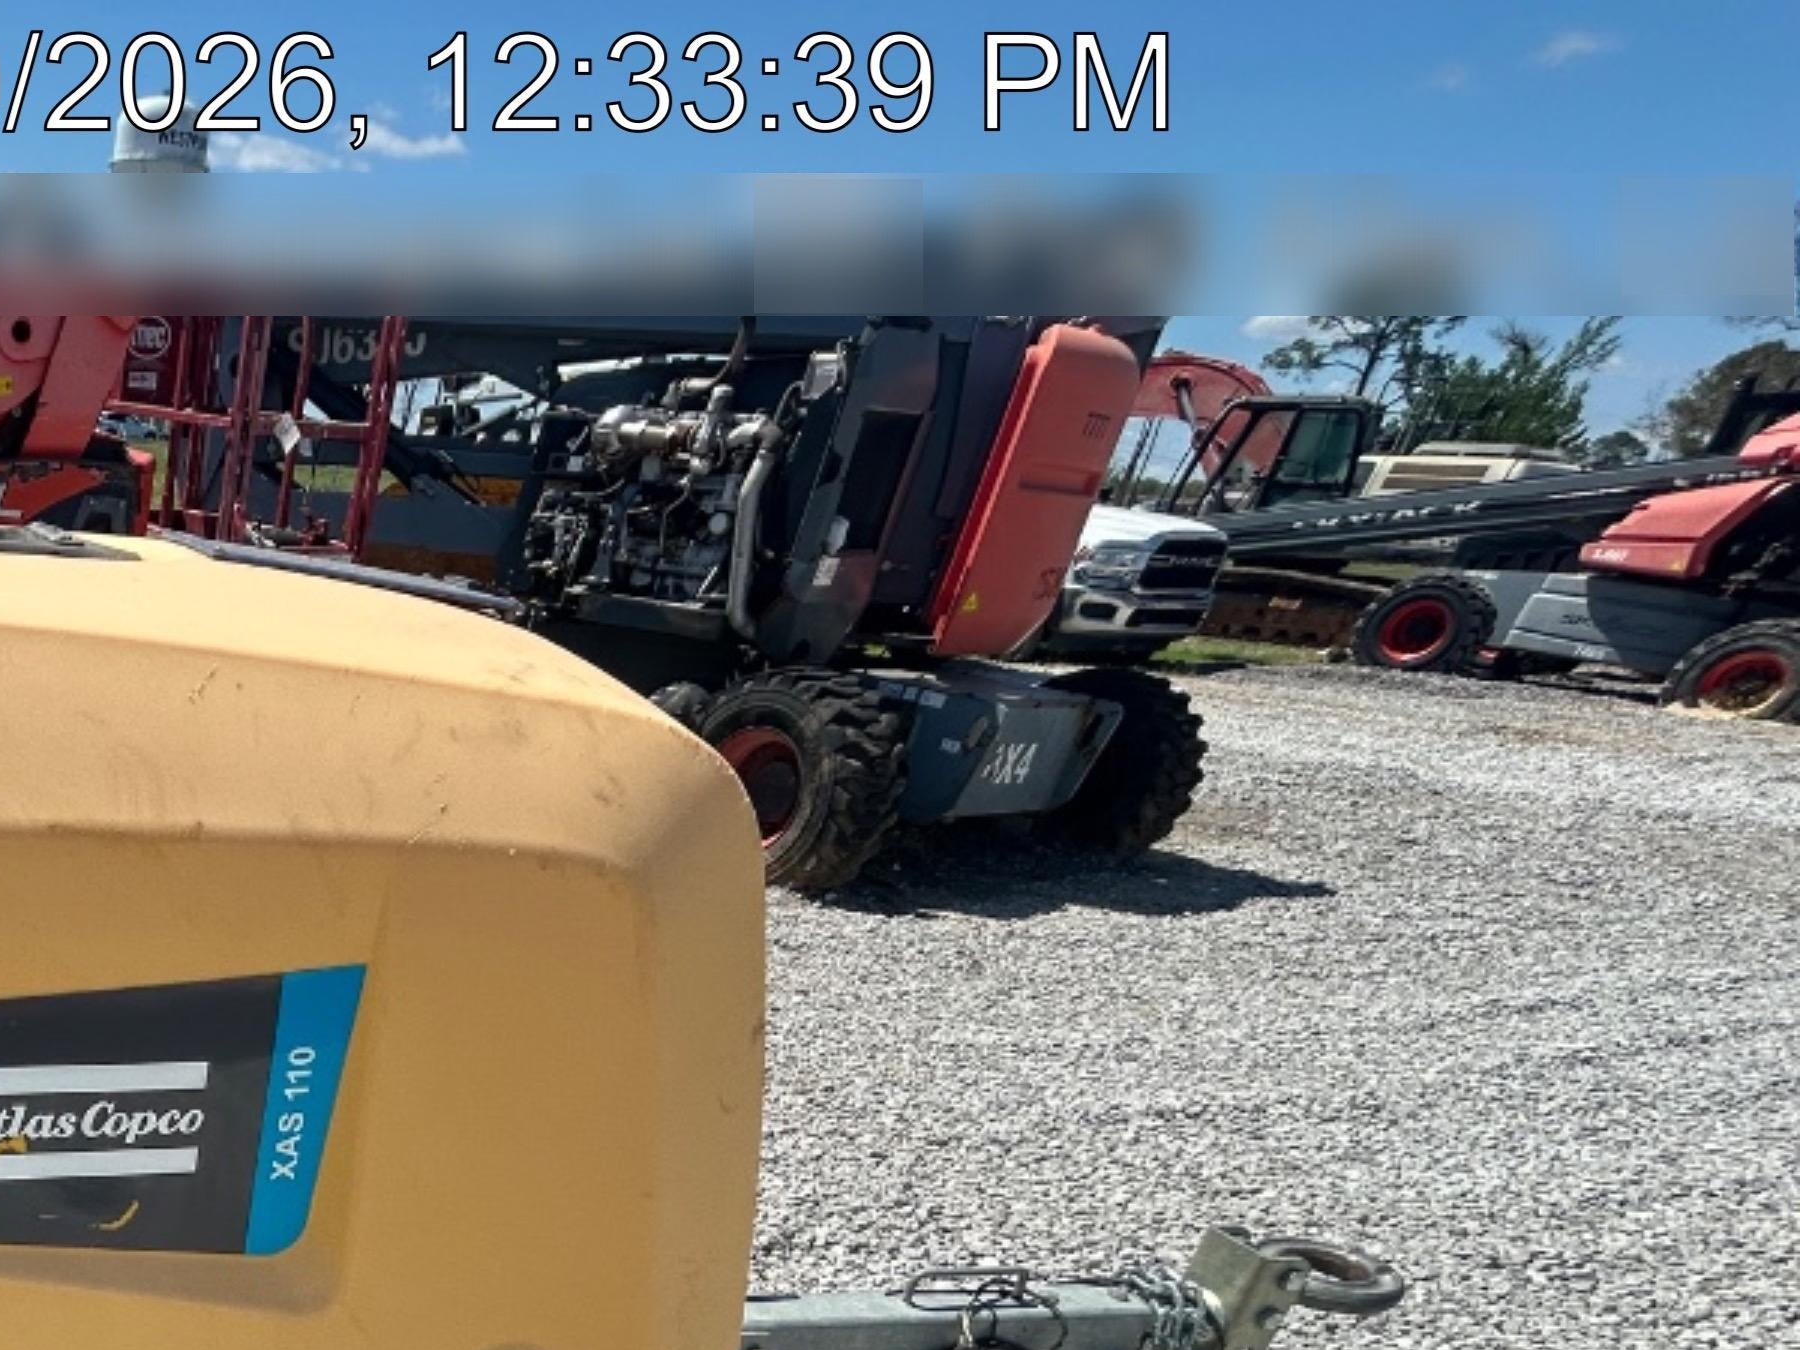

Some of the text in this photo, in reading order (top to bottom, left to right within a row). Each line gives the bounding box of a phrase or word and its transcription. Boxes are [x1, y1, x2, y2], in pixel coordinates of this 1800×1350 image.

[80, 1100, 205, 1144] Copco
[270, 1046, 316, 1180] XAS 110
